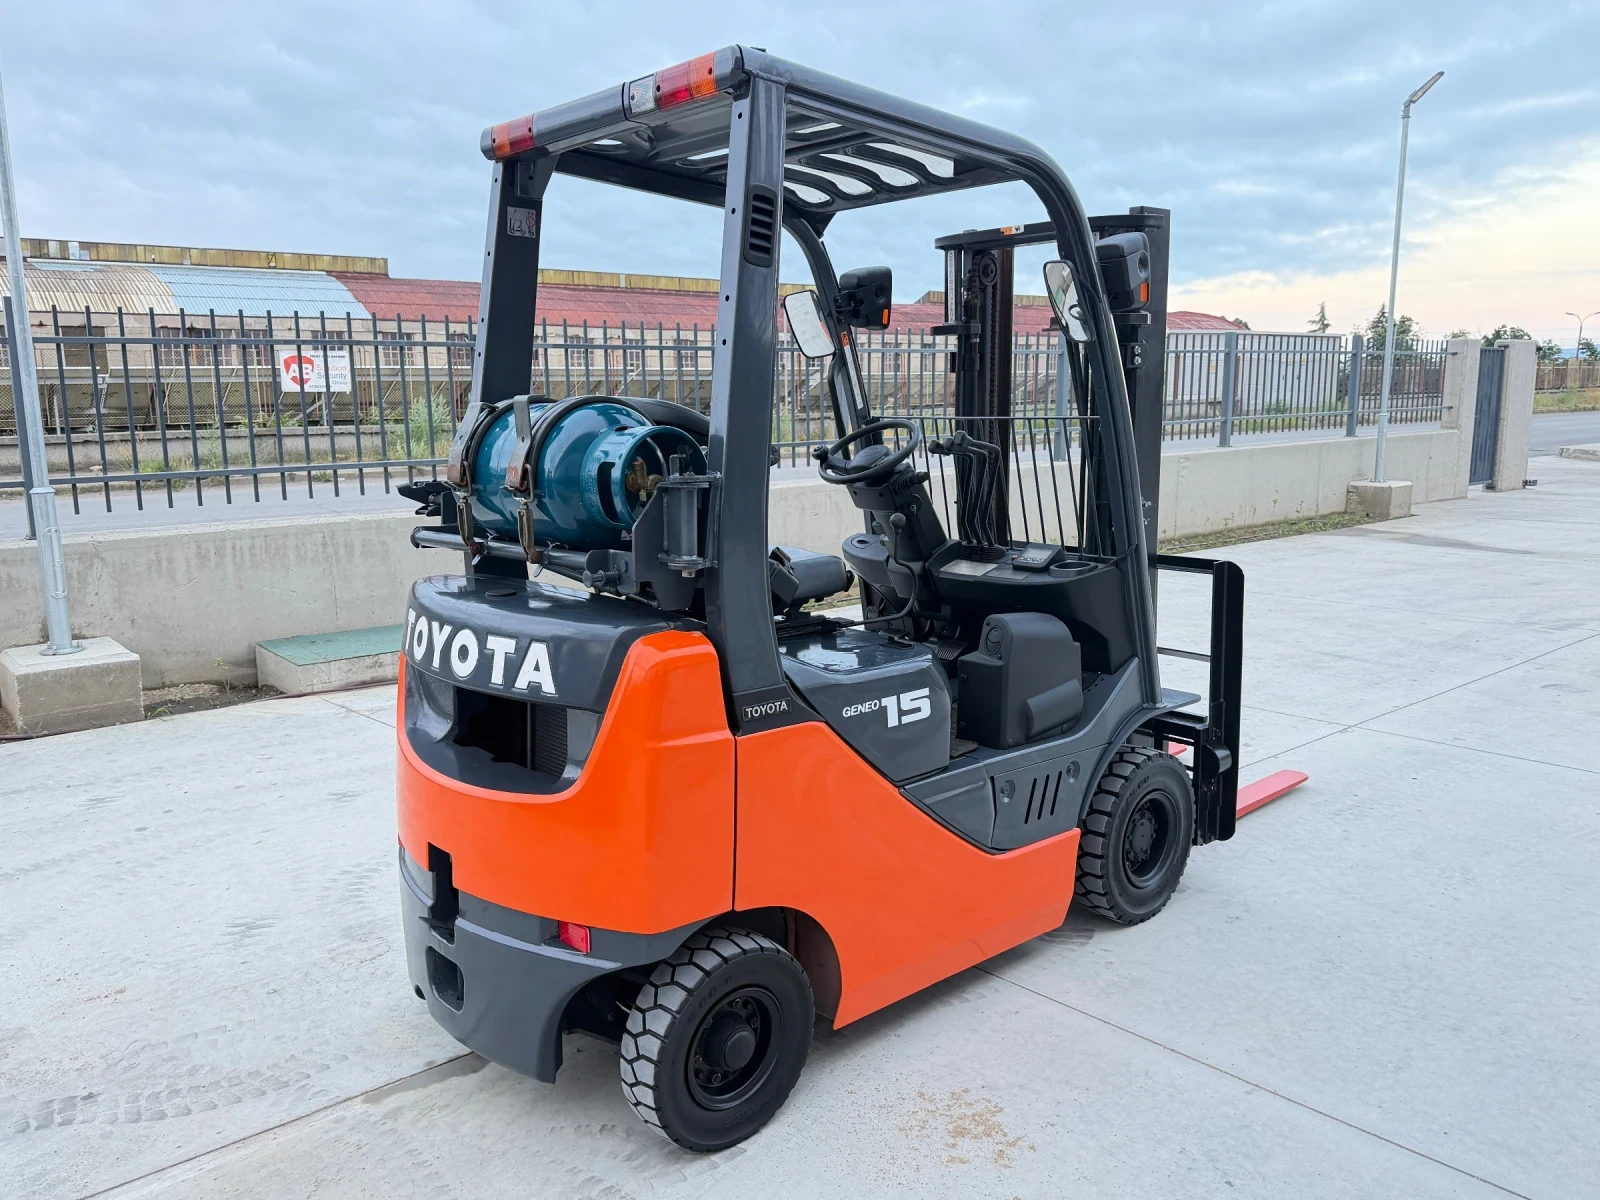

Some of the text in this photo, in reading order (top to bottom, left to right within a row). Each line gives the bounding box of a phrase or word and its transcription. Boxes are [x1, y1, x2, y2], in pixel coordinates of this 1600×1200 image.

[287, 363, 313, 379] AB
[316, 364, 347, 372] Sution
[317, 372, 347, 380] Surity
[405, 607, 557, 696] TOYOTA
[745, 701, 789, 718] TOYOTA
[842, 687, 932, 728] GENEO 15
